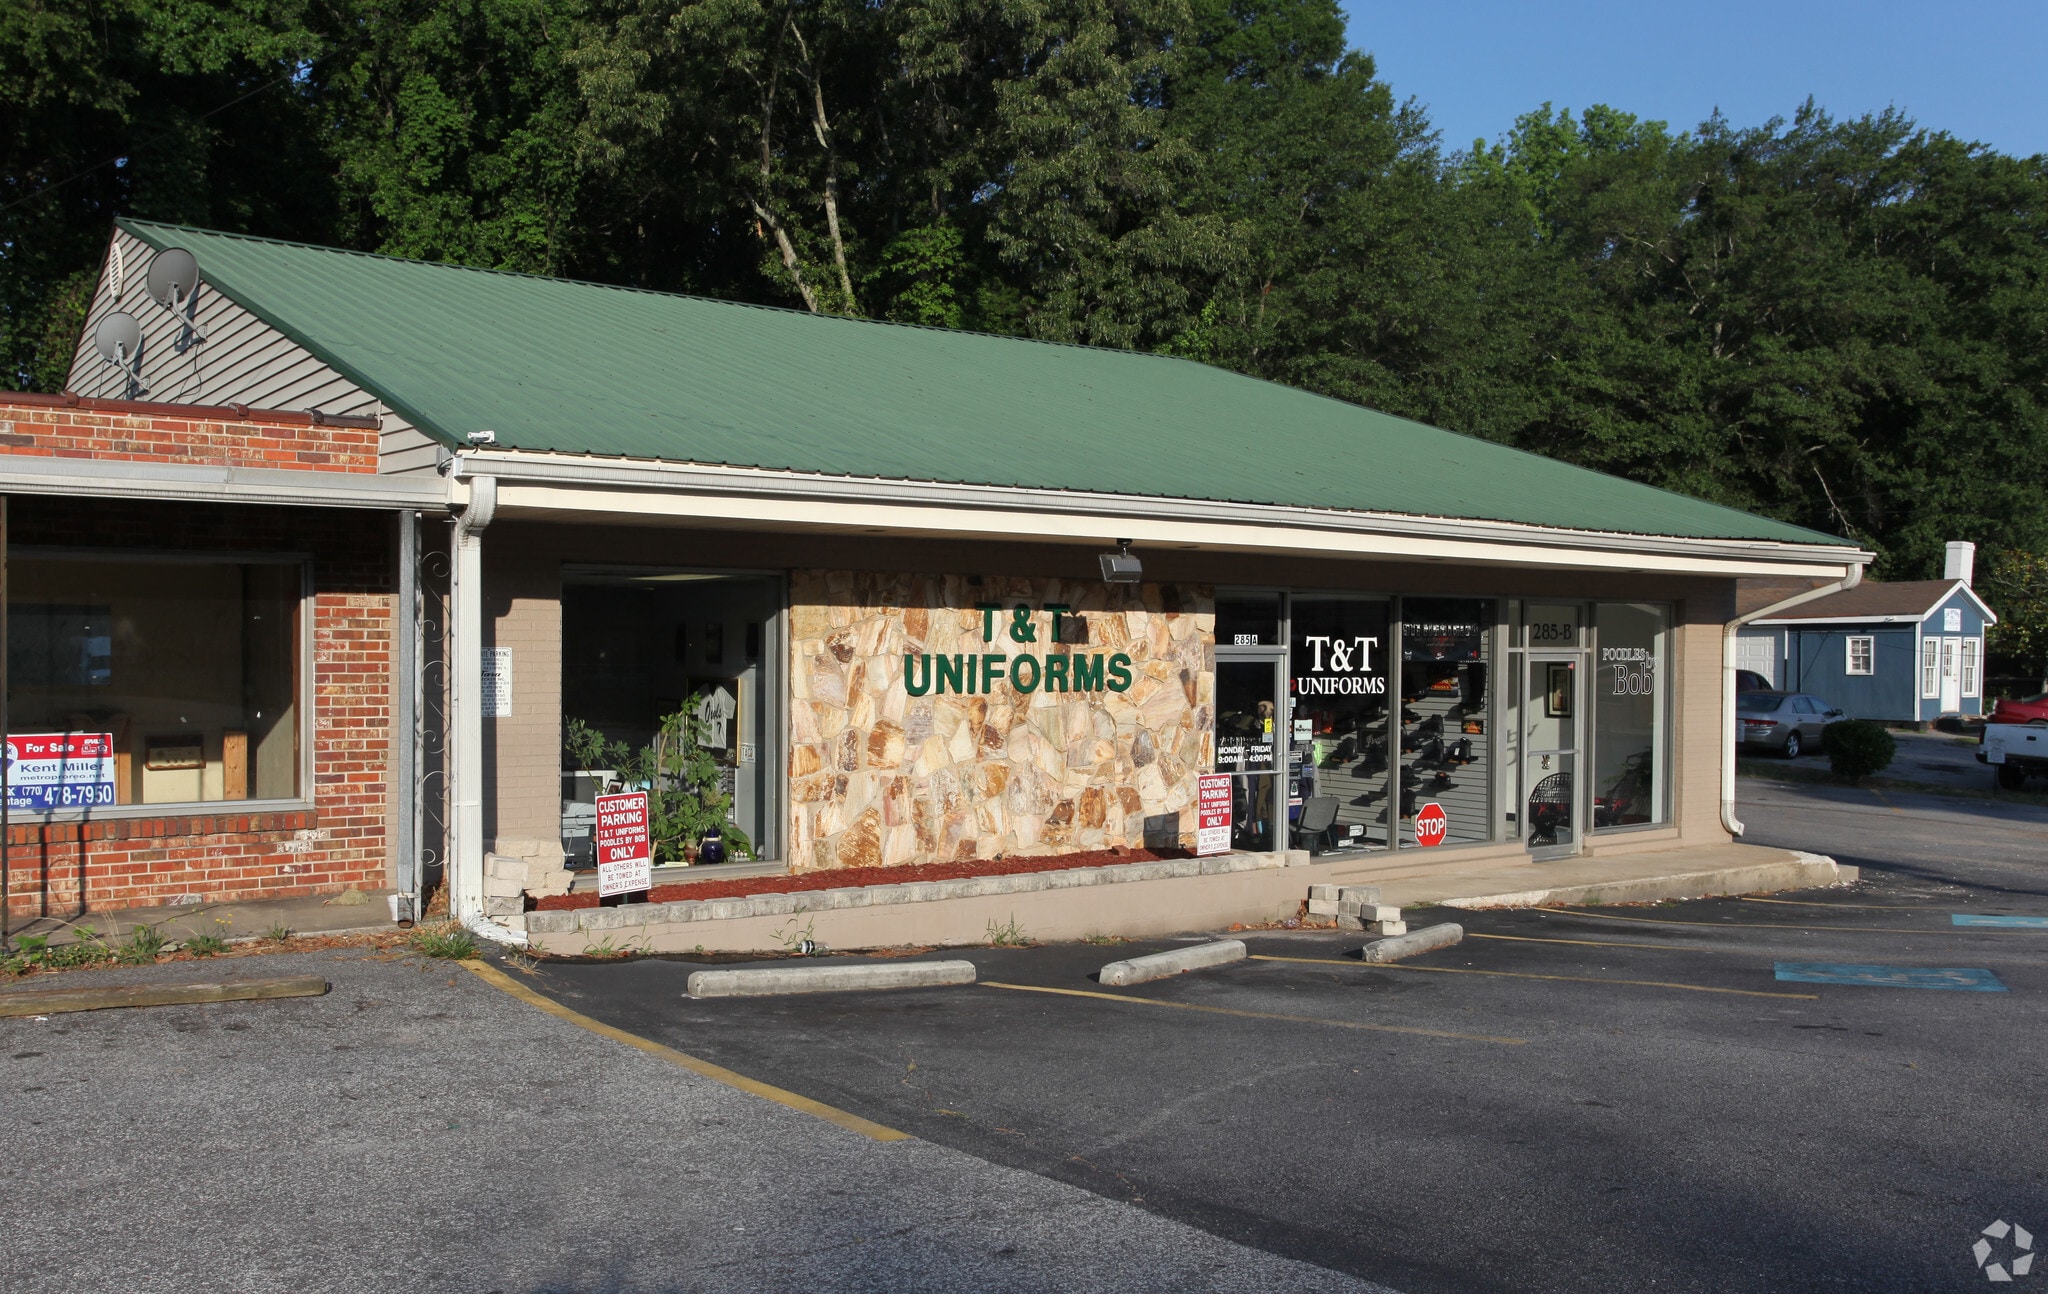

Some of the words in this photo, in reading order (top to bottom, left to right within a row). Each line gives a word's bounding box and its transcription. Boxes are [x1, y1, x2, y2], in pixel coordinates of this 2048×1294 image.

[1532, 624, 1572, 640] 285-B
[1235, 635, 1250, 645] 285
[1306, 636, 1378, 672] T&T
[1602, 648, 1645, 661] POODLES
[904, 653, 1132, 696] UNIFORMS
[1613, 662, 1654, 695] Bob
[1297, 677, 1384, 695] UNIFORMS
[26, 743, 44, 752] For
[50, 742, 74, 752] Sale
[1218, 746, 1244, 754] MONDAY
[21, 763, 56, 772] Kent
[64, 763, 104, 771] Miller
[1200, 778, 1230, 789] CUSTOMER
[22, 786, 42, 796] (770)
[45, 785, 112, 805] 478-7950
[1202, 789, 1228, 800] PARKING
[599, 798, 645, 813] CUSTOMER
[1211, 800, 1230, 808] UNIFORMS
[602, 811, 642, 827] PARKING
[1207, 816, 1223, 826] ONLY
[600, 830, 613, 838] T&T
[616, 826, 645, 836] UNIFORMS
[1417, 818, 1444, 836] STOP
[600, 838, 623, 847] POODLES
[626, 836, 632, 844] BY
[610, 846, 636, 860] ONLY
[614, 863, 633, 871] OTHERS
[616, 872, 632, 880] TOWED
[624, 878, 648, 888] EXPENSE
